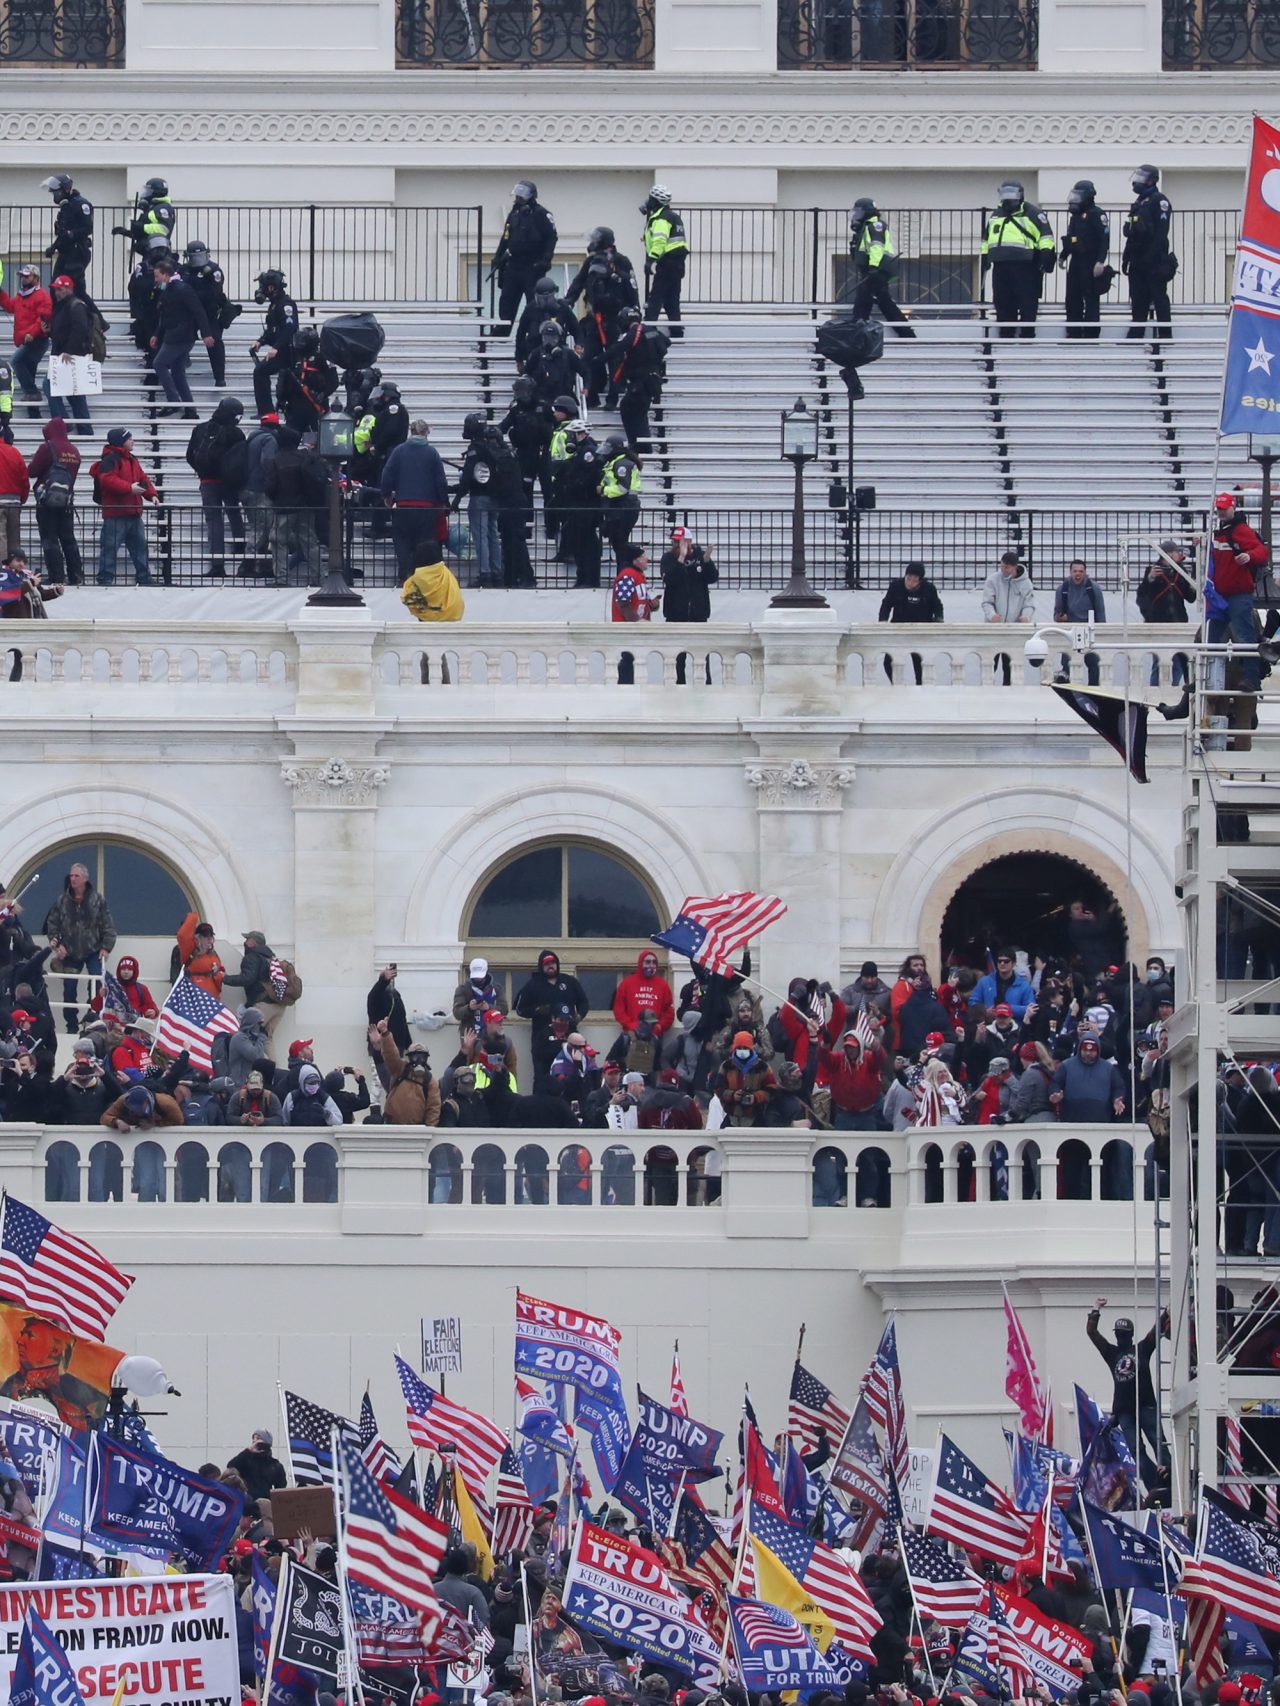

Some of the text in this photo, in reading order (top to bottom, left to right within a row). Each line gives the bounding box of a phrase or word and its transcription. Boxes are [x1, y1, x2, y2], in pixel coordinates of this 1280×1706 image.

[433, 1318, 456, 1338] FAIR
[517, 1300, 619, 1350] TRUMP
[517, 1323, 546, 1337] KEEP
[547, 1330, 596, 1352] AMERICA
[424, 1338, 460, 1357] ELECTIONS
[425, 1355, 458, 1373] MATTER
[536, 1347, 609, 1388] 2020
[580, 1404, 602, 1420] KEEP
[113, 1455, 227, 1523] TRUMP
[624, 1480, 671, 1529] EEP AMERIC
[58, 1511, 81, 1527] KEEP
[107, 1512, 170, 1532] KEEP AMER
[587, 1530, 631, 1552] Re-Elect
[588, 1539, 677, 1597] TRUM
[580, 1568, 666, 1613] KEEP AMERICA
[358, 1592, 417, 1623] TRU
[592, 1594, 686, 1650] 2020
[801, 1603, 819, 1613] DON'T
[93, 1623, 164, 1650] FRAUD
[171, 1617, 230, 1644] NOW.
[570, 1611, 584, 1621] For
[626, 1633, 641, 1645] The
[644, 1641, 670, 1657] United
[997, 1600, 1081, 1668] UMP
[32, 1636, 84, 1706] TRU
[764, 1649, 835, 1672] UTA
[957, 1657, 988, 1677] resident
[1034, 1660, 1080, 1691] GREAT!
[10, 1658, 205, 1698] SECUTE
[766, 1672, 841, 1685] FOR TRUM
